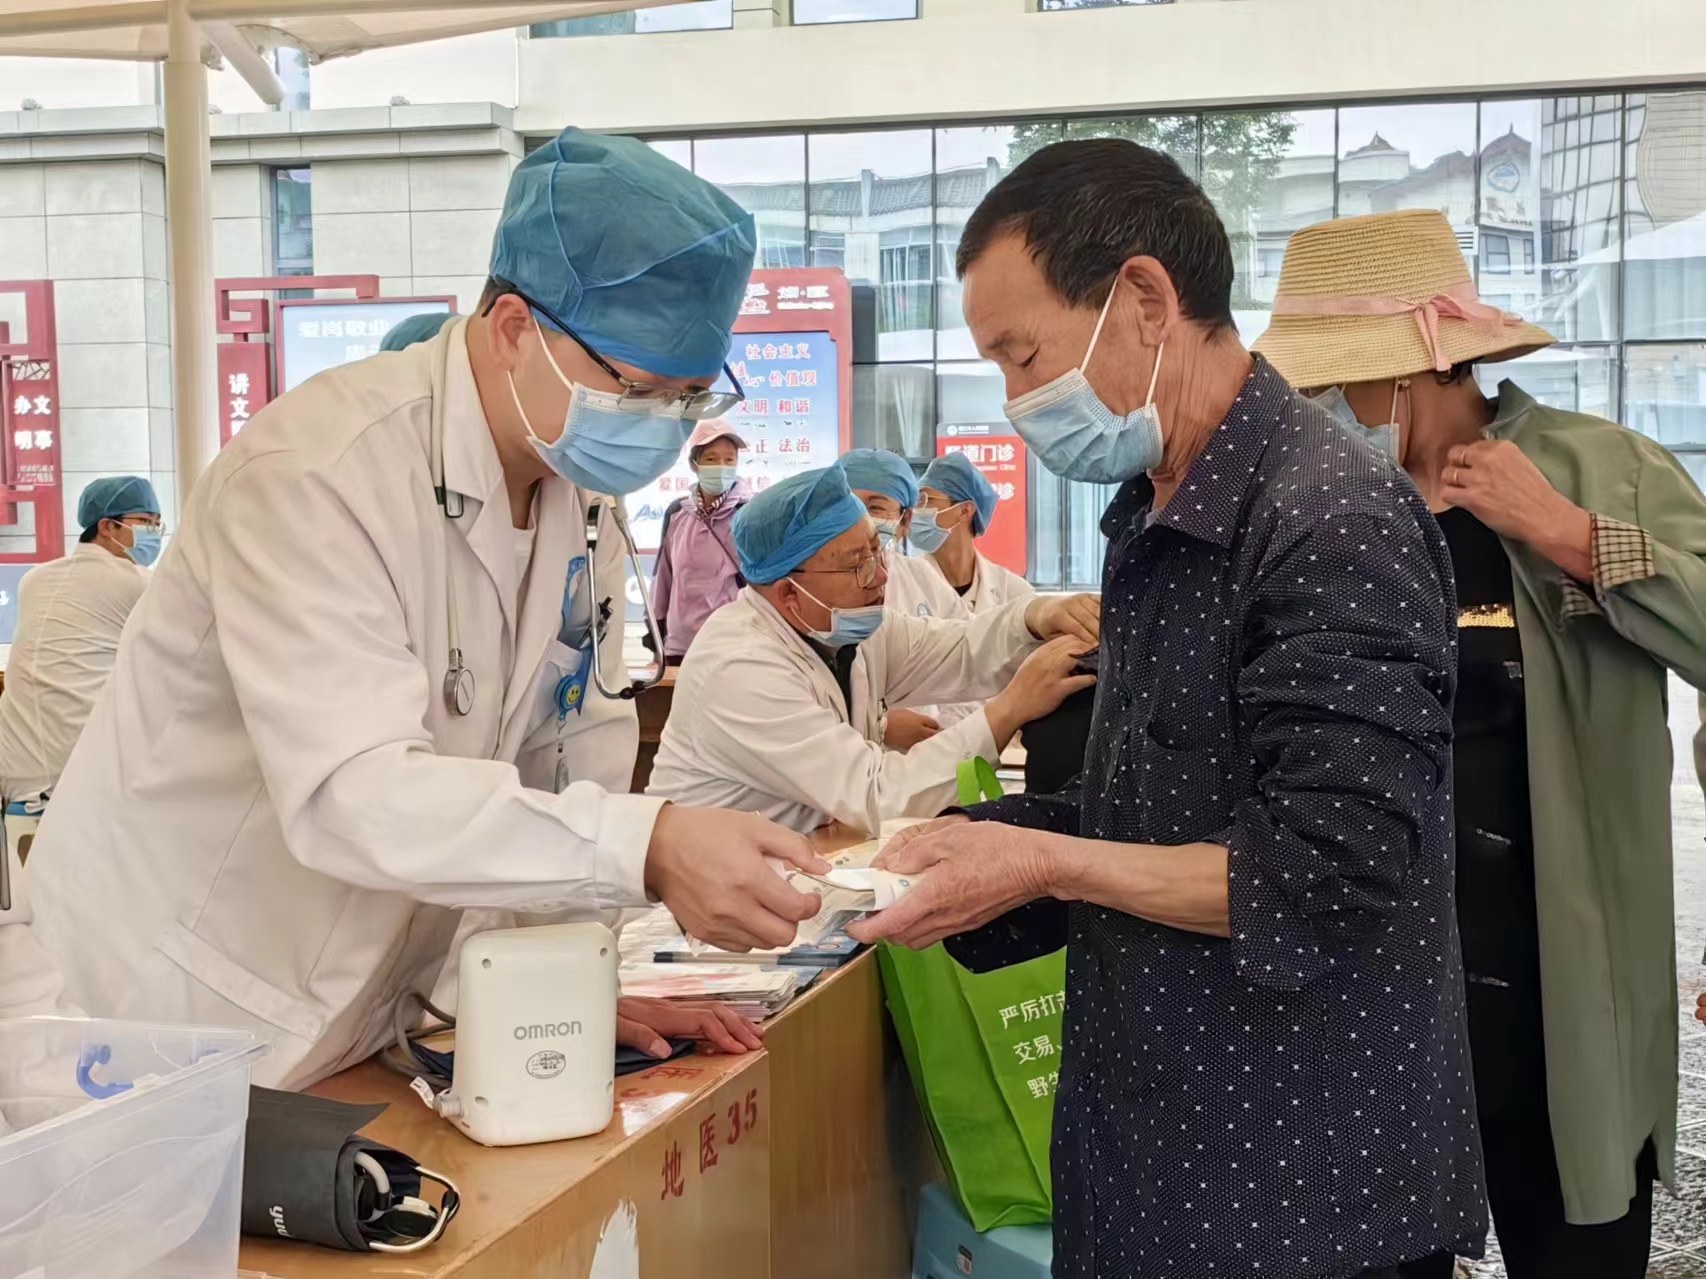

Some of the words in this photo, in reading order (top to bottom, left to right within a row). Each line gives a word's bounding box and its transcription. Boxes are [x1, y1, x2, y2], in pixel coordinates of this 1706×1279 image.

[745, 343, 811, 360] 社会主义
[738, 398, 768, 416] 文明
[777, 398, 810, 416] 和谐
[778, 438, 810, 453] 法治
[990, 482, 1014, 501] 诊
[513, 1020, 582, 1040] OMRON
